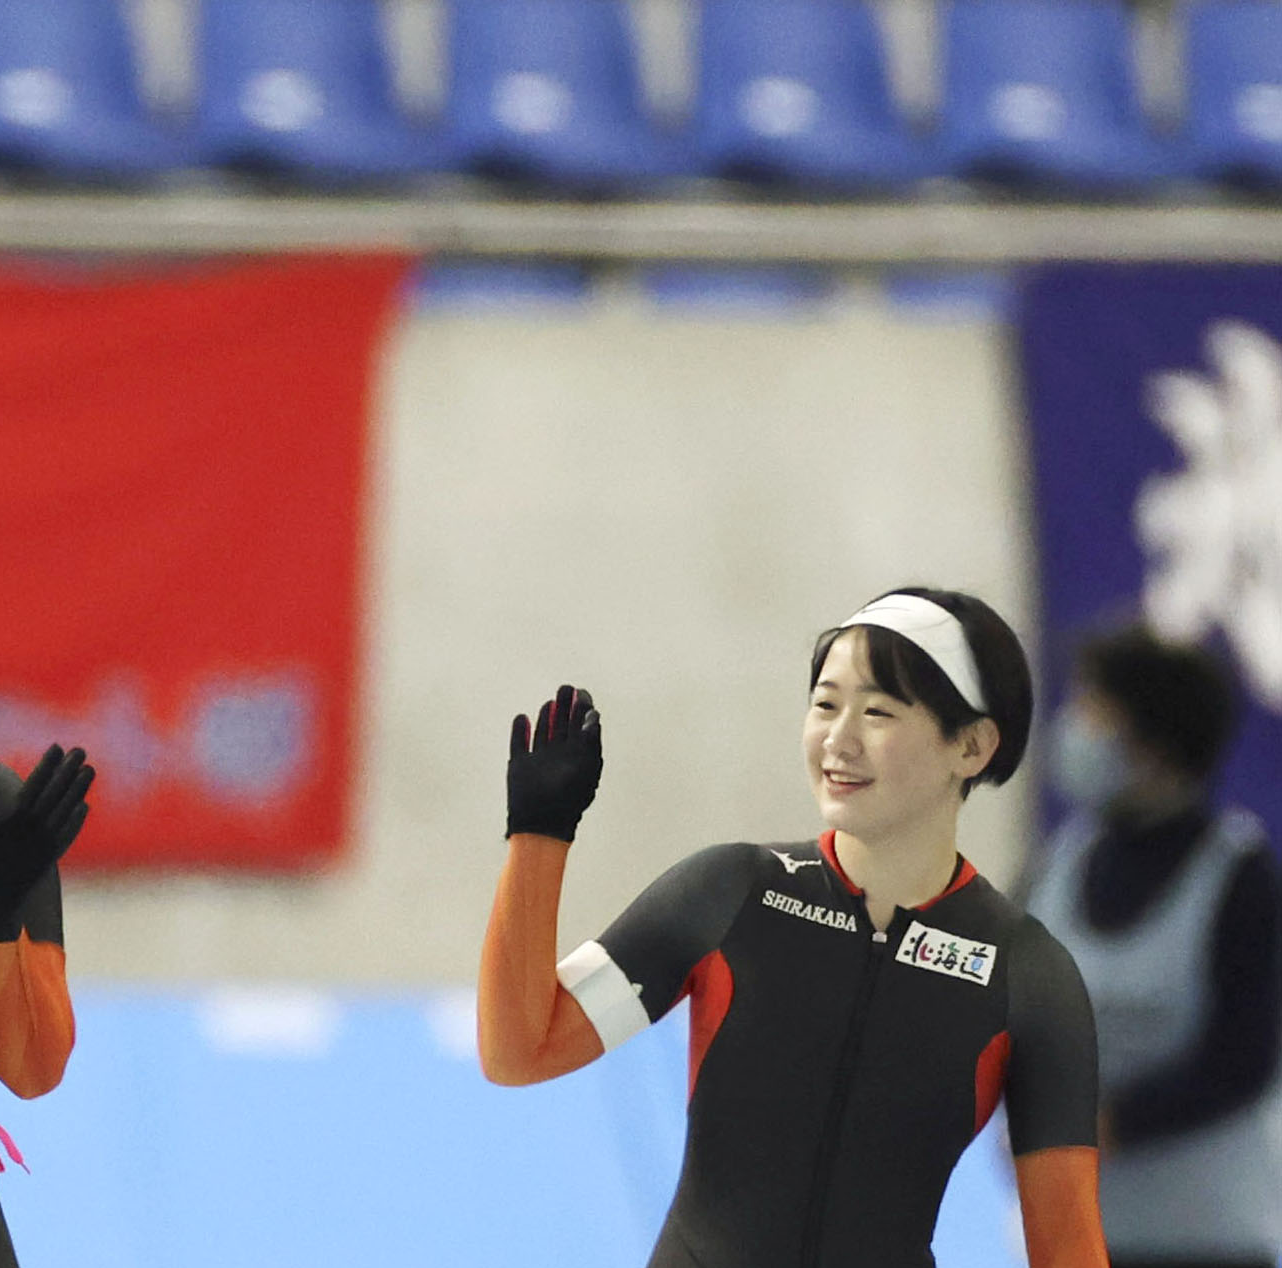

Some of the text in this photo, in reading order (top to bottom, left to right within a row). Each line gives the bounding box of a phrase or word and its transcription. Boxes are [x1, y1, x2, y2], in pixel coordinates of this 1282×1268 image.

[761, 889, 858, 933] SHIRAKABA
[903, 931, 990, 981] 北海道
